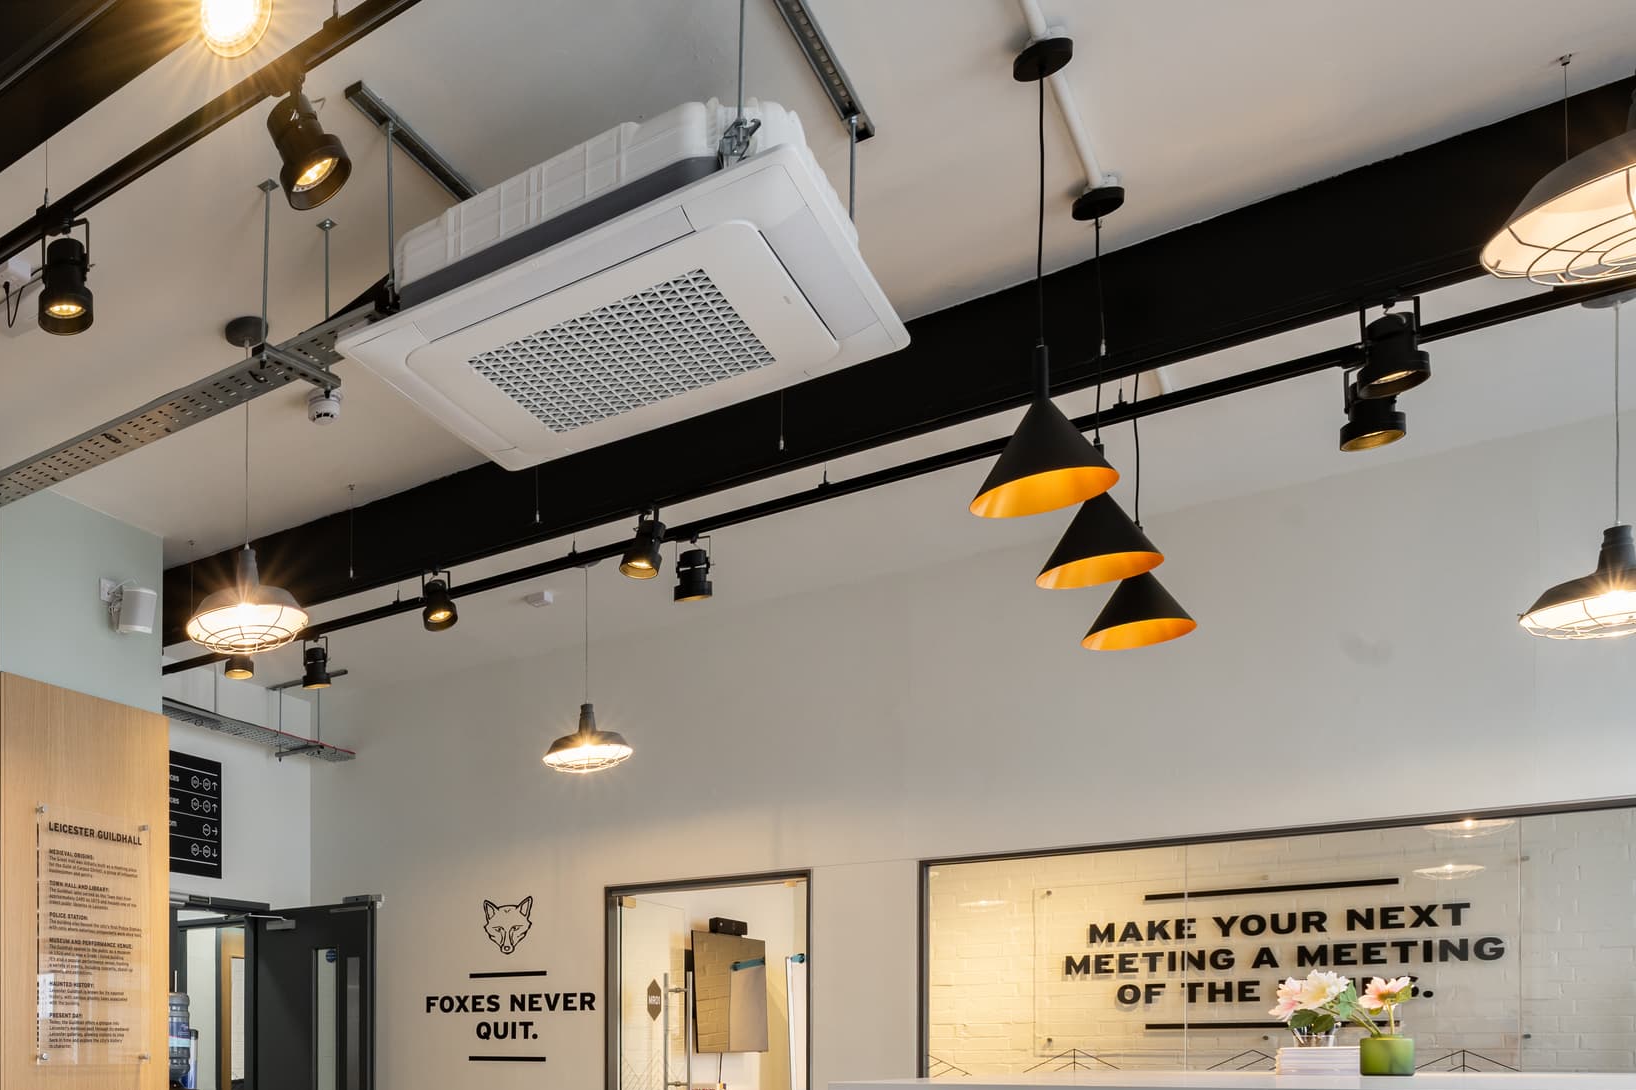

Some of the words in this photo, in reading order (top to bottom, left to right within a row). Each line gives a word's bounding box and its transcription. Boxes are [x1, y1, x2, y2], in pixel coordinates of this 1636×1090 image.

[48, 821, 96, 839] LEICESTER
[97, 829, 143, 847] GUILDHALL
[1088, 917, 1197, 945] MAKE
[1212, 910, 1328, 938] YOUR
[1346, 902, 1471, 931] NEXT
[1065, 949, 1236, 976] MEETING
[1251, 946, 1279, 969] A
[1297, 936, 1506, 968] MEETING
[426, 994, 501, 1014] FOXES
[510, 992, 596, 1012] NEVER
[1117, 983, 1167, 1006] OF
[1181, 981, 1261, 1004] THE
[476, 1021, 538, 1041] QUIT.
